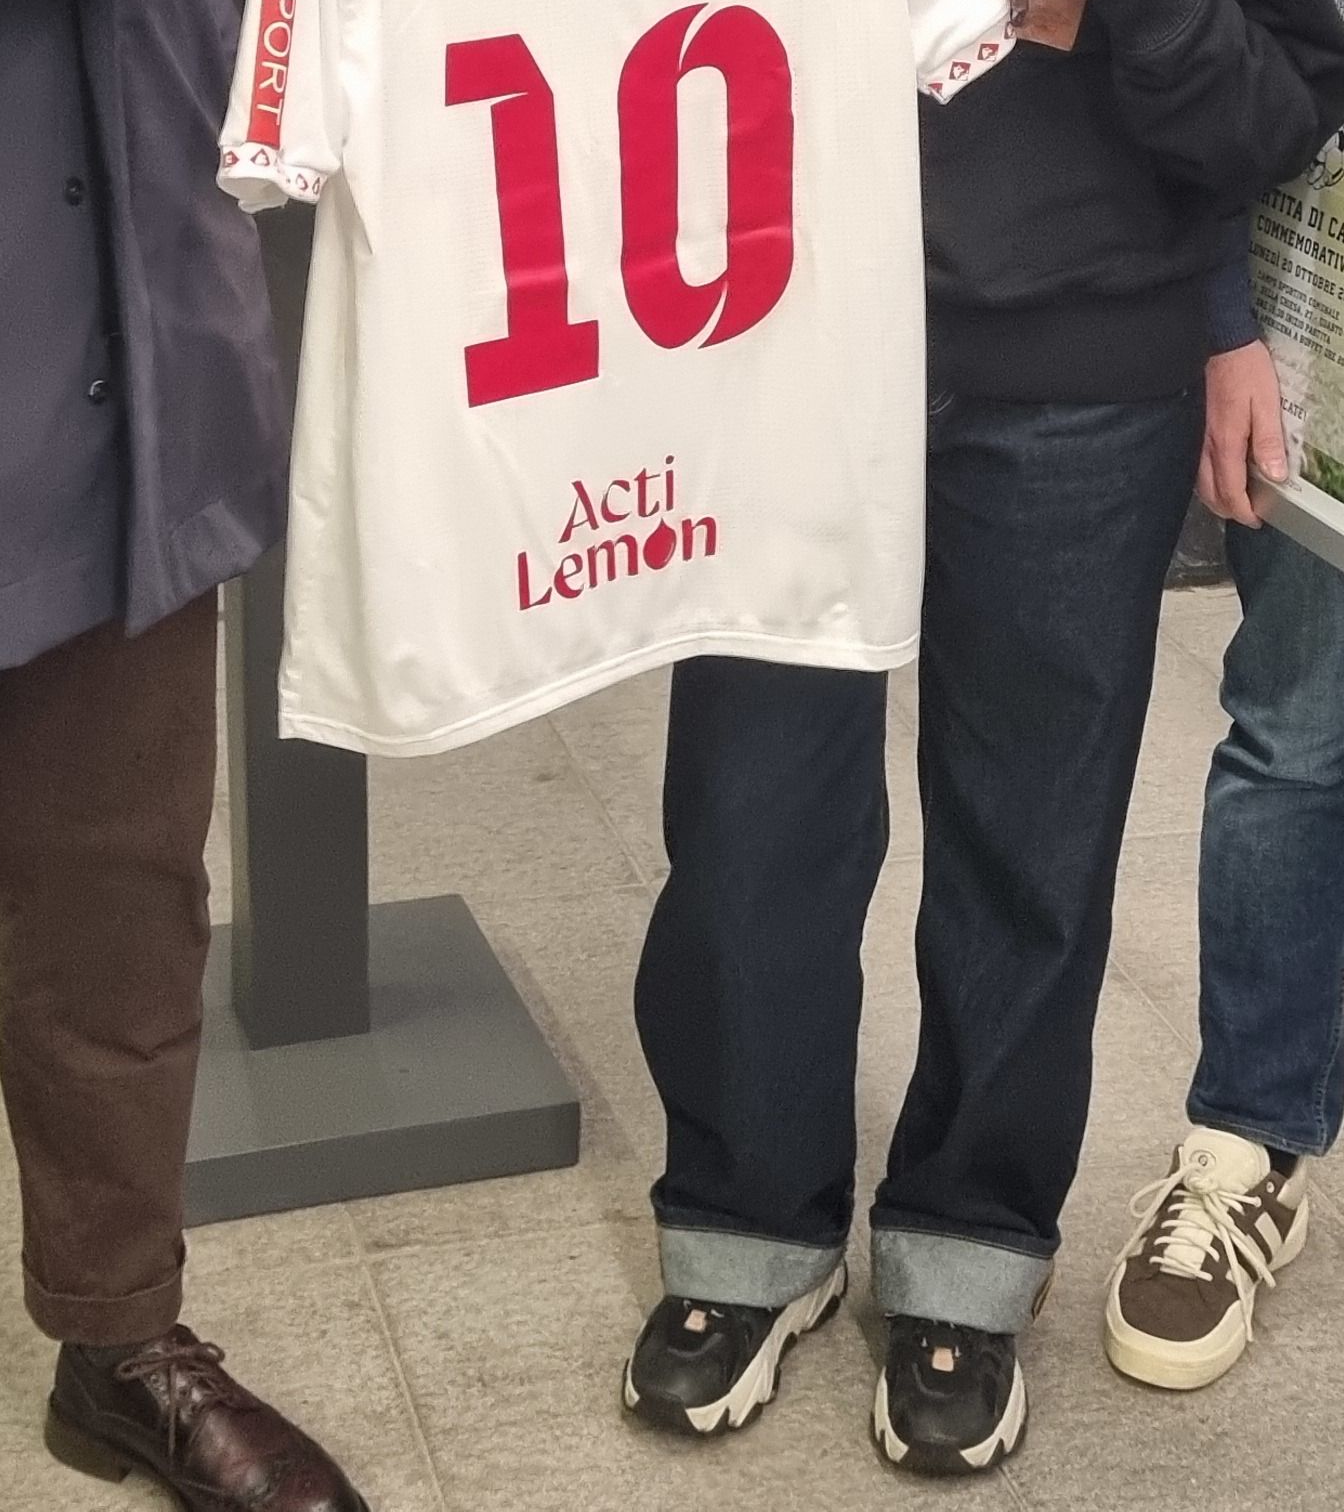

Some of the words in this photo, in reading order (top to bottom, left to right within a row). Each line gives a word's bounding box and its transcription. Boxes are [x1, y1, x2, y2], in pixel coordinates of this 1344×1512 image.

[443, 1, 795, 409] 10
[1259, 188, 1302, 222] RTITA
[1308, 206, 1324, 231] DI
[1281, 258, 1293, 273] 20
[1295, 265, 1336, 296] OTTOBRE
[557, 454, 675, 544] Acti
[516, 516, 718, 611] Lemon
